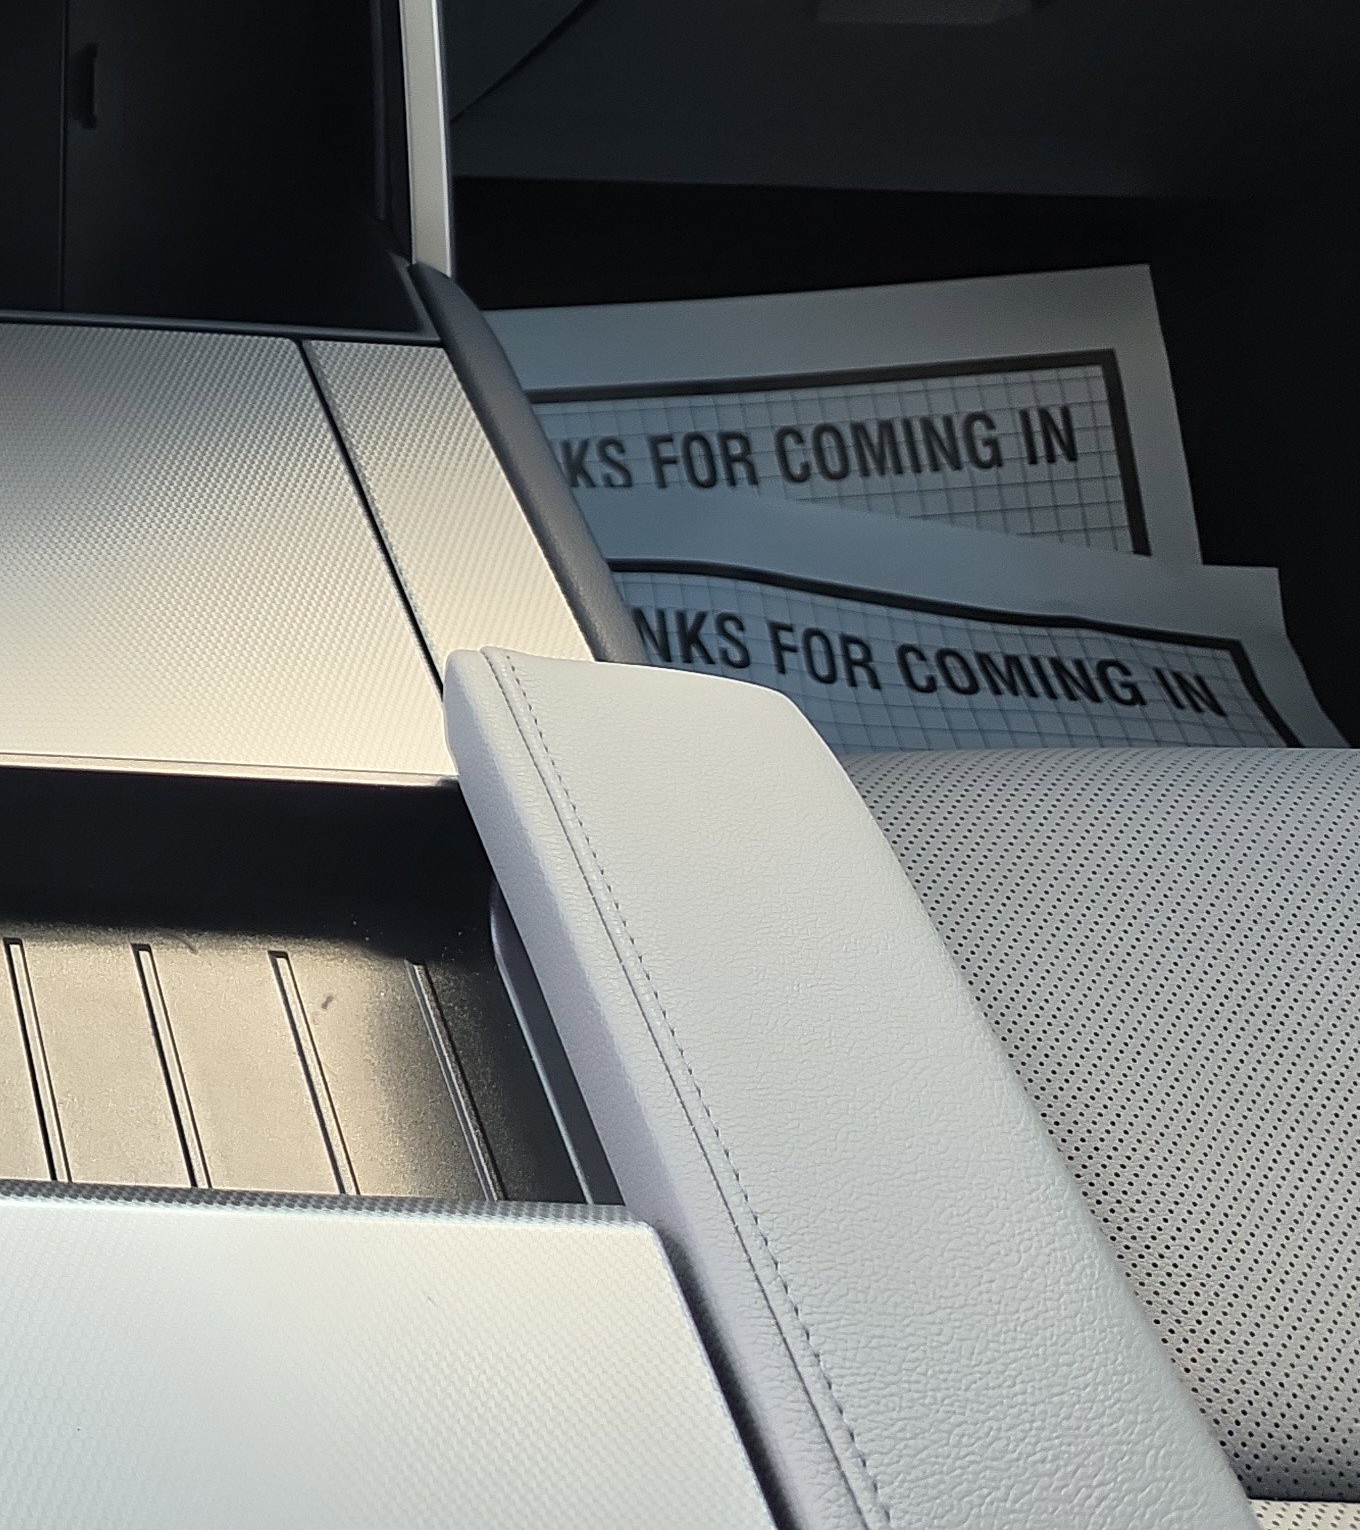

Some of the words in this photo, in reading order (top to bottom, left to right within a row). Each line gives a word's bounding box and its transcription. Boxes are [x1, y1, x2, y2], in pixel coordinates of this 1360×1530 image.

[648, 431, 759, 488] FOR
[775, 409, 1001, 484] COMING
[1019, 405, 1077, 465] IN
[771, 625, 880, 690] FOR
[898, 641, 1141, 710] COMING
[1163, 668, 1228, 719] IN
